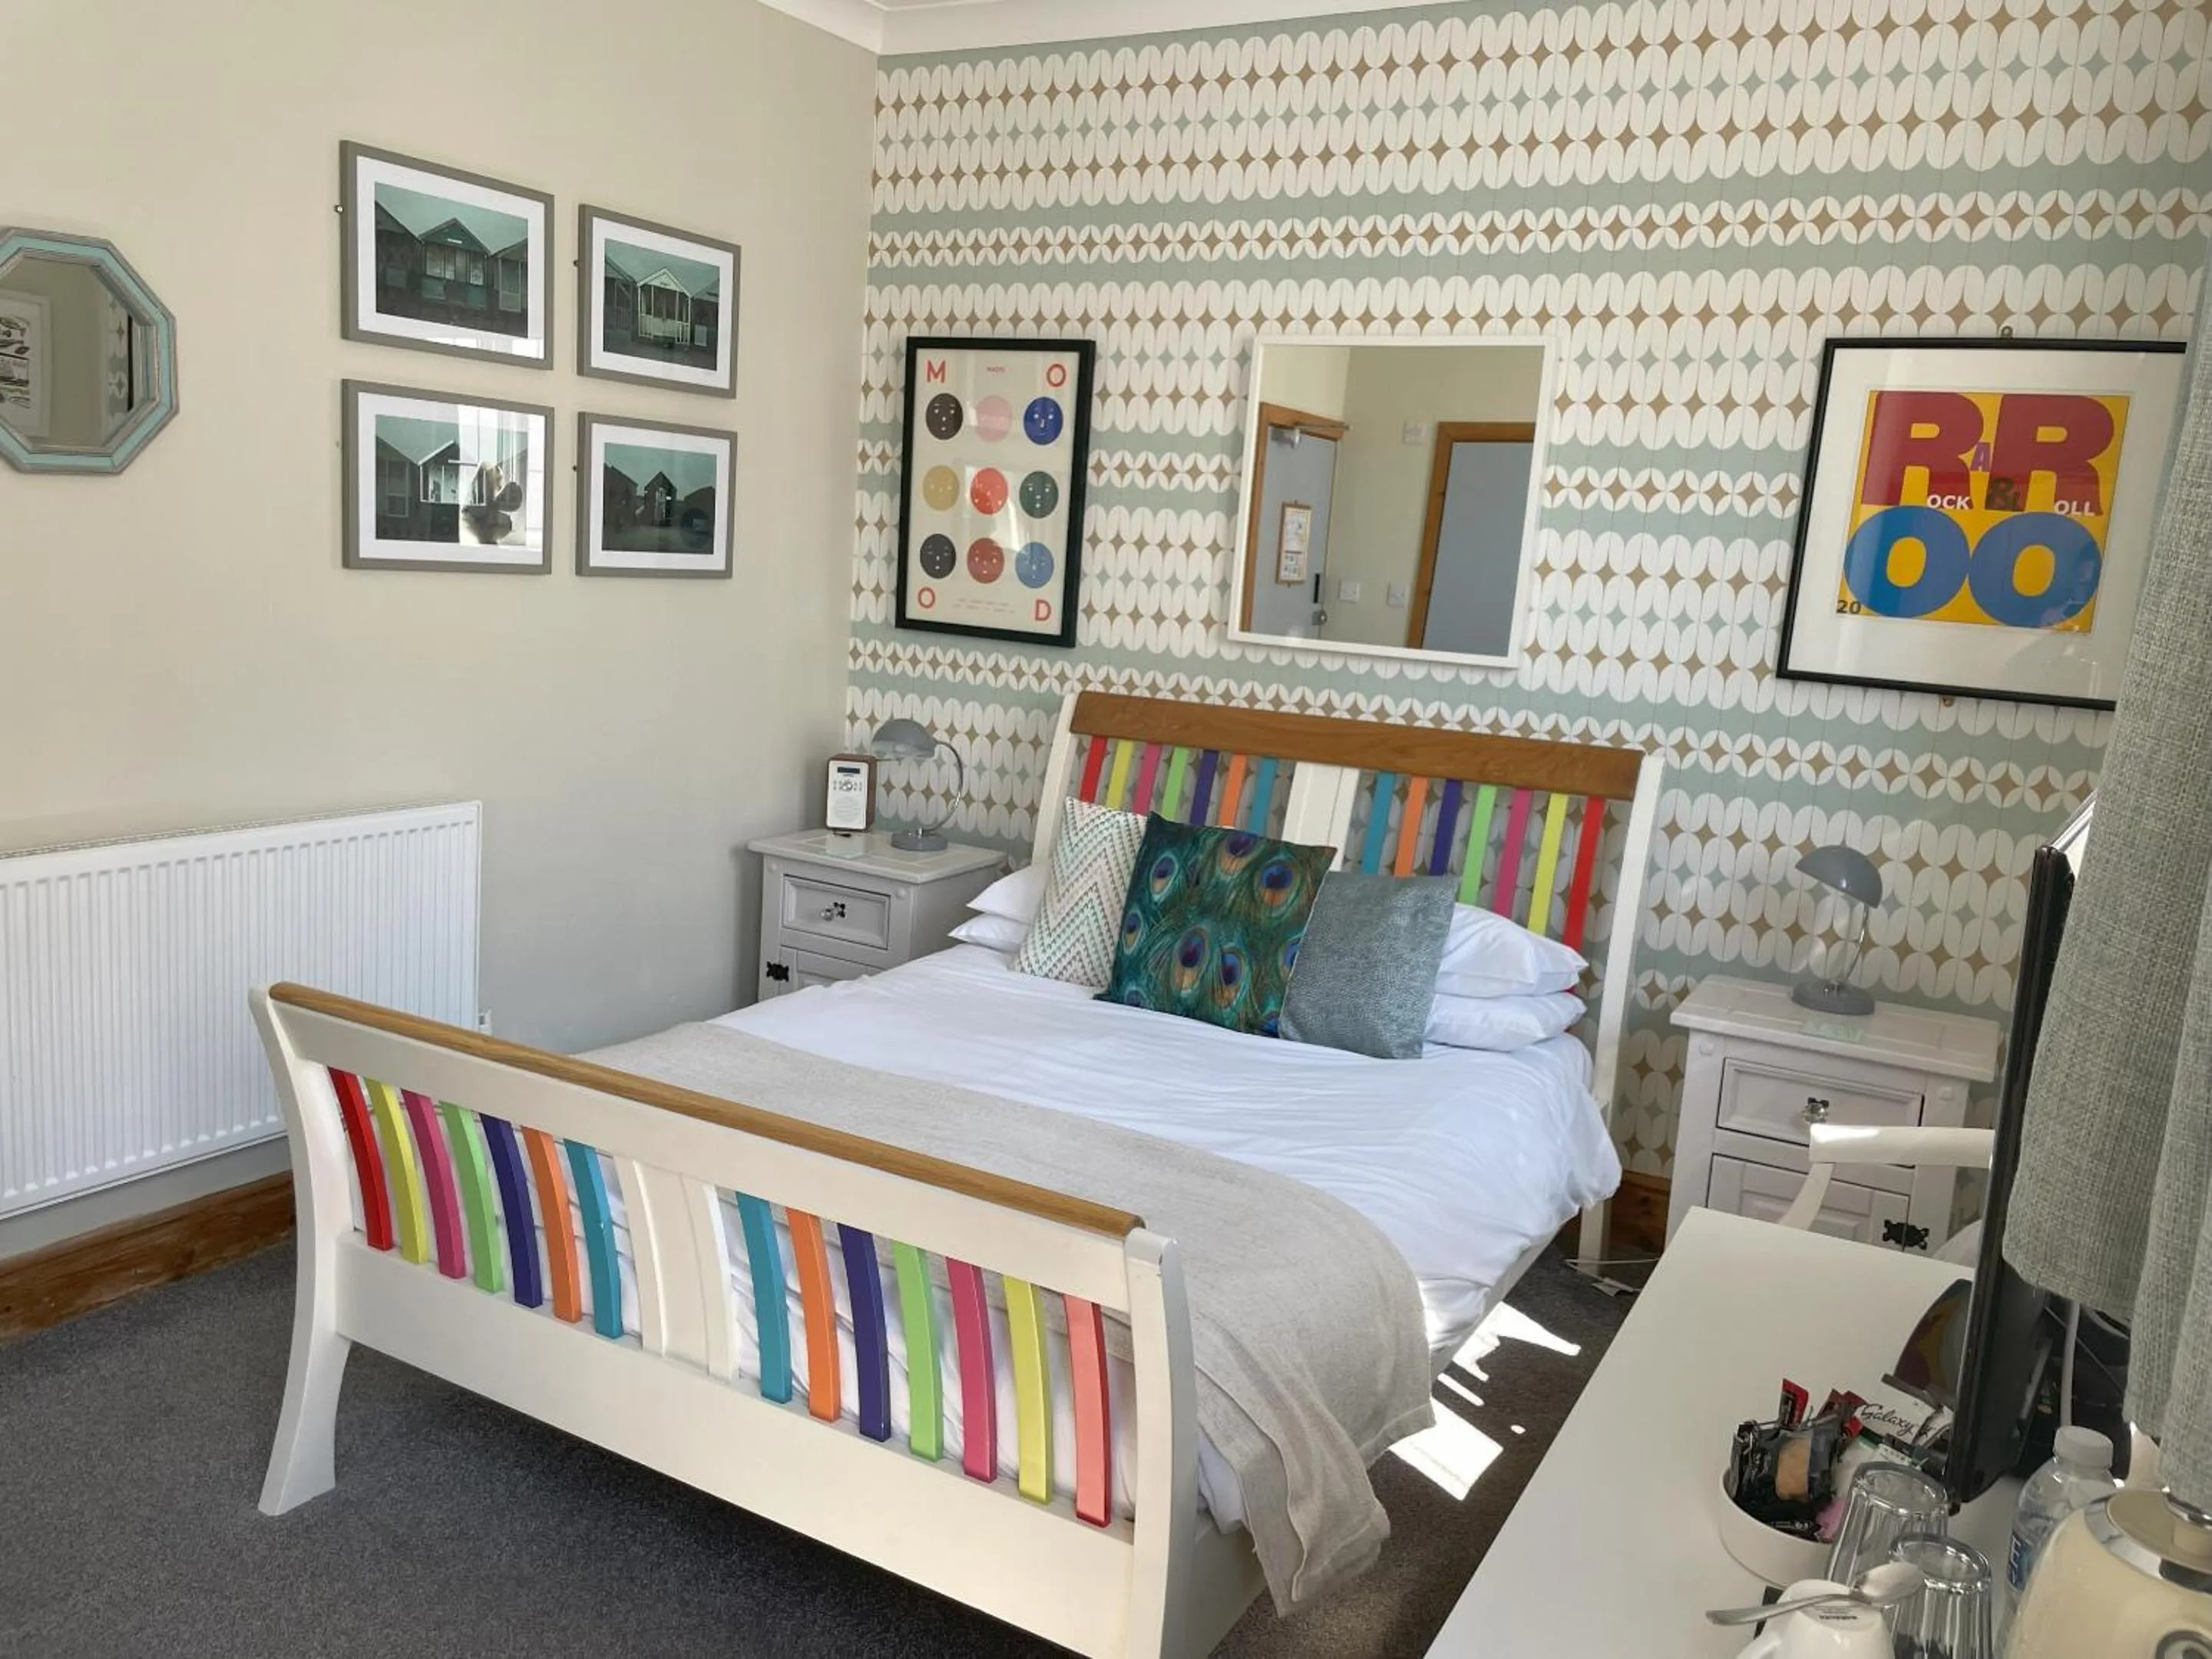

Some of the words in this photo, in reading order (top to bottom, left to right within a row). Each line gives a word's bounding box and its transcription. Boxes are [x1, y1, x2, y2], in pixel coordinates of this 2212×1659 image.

[926, 360, 946, 383] M
[1046, 363, 1066, 387] O
[918, 587, 936, 609] O
[1035, 599, 1052, 621] D
[1836, 600, 1862, 615] 20
[1860, 1403, 1915, 1436] Galaxy
